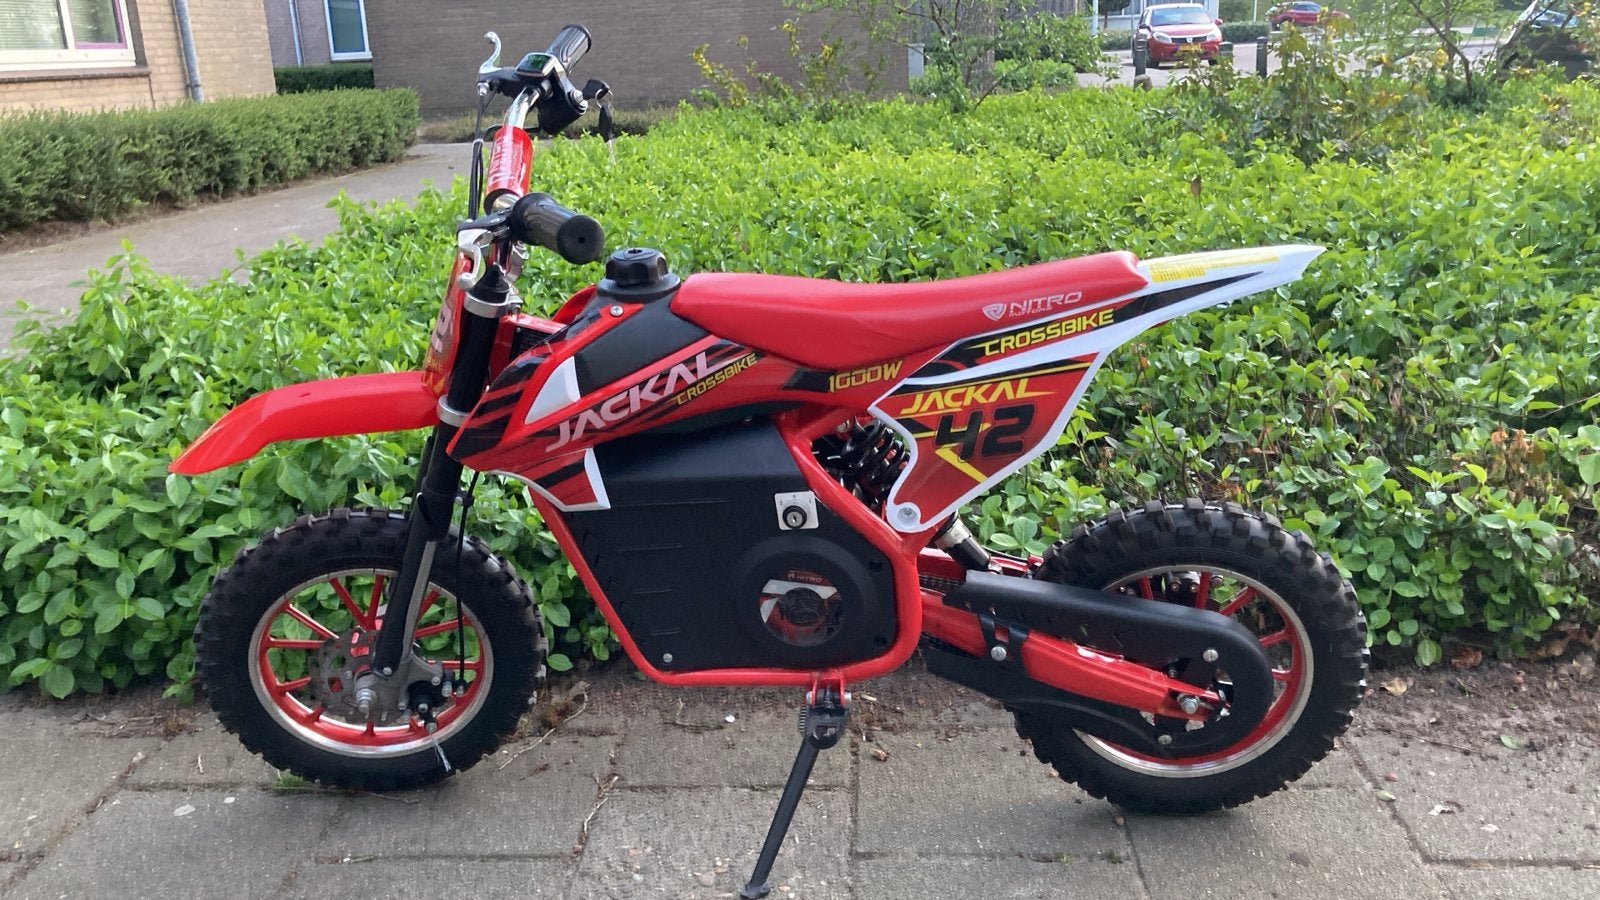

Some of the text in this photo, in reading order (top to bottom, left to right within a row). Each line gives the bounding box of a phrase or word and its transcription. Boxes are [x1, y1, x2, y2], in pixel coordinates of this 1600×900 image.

[1009, 291, 1082, 314] NITRO
[968, 308, 1114, 356] CROSSBIKE
[674, 353, 758, 405] CROSSBIKE
[829, 360, 903, 393] 1000W
[900, 377, 1060, 415] JACKAL
[546, 352, 752, 452] JACKAL
[934, 402, 1036, 463] 42
